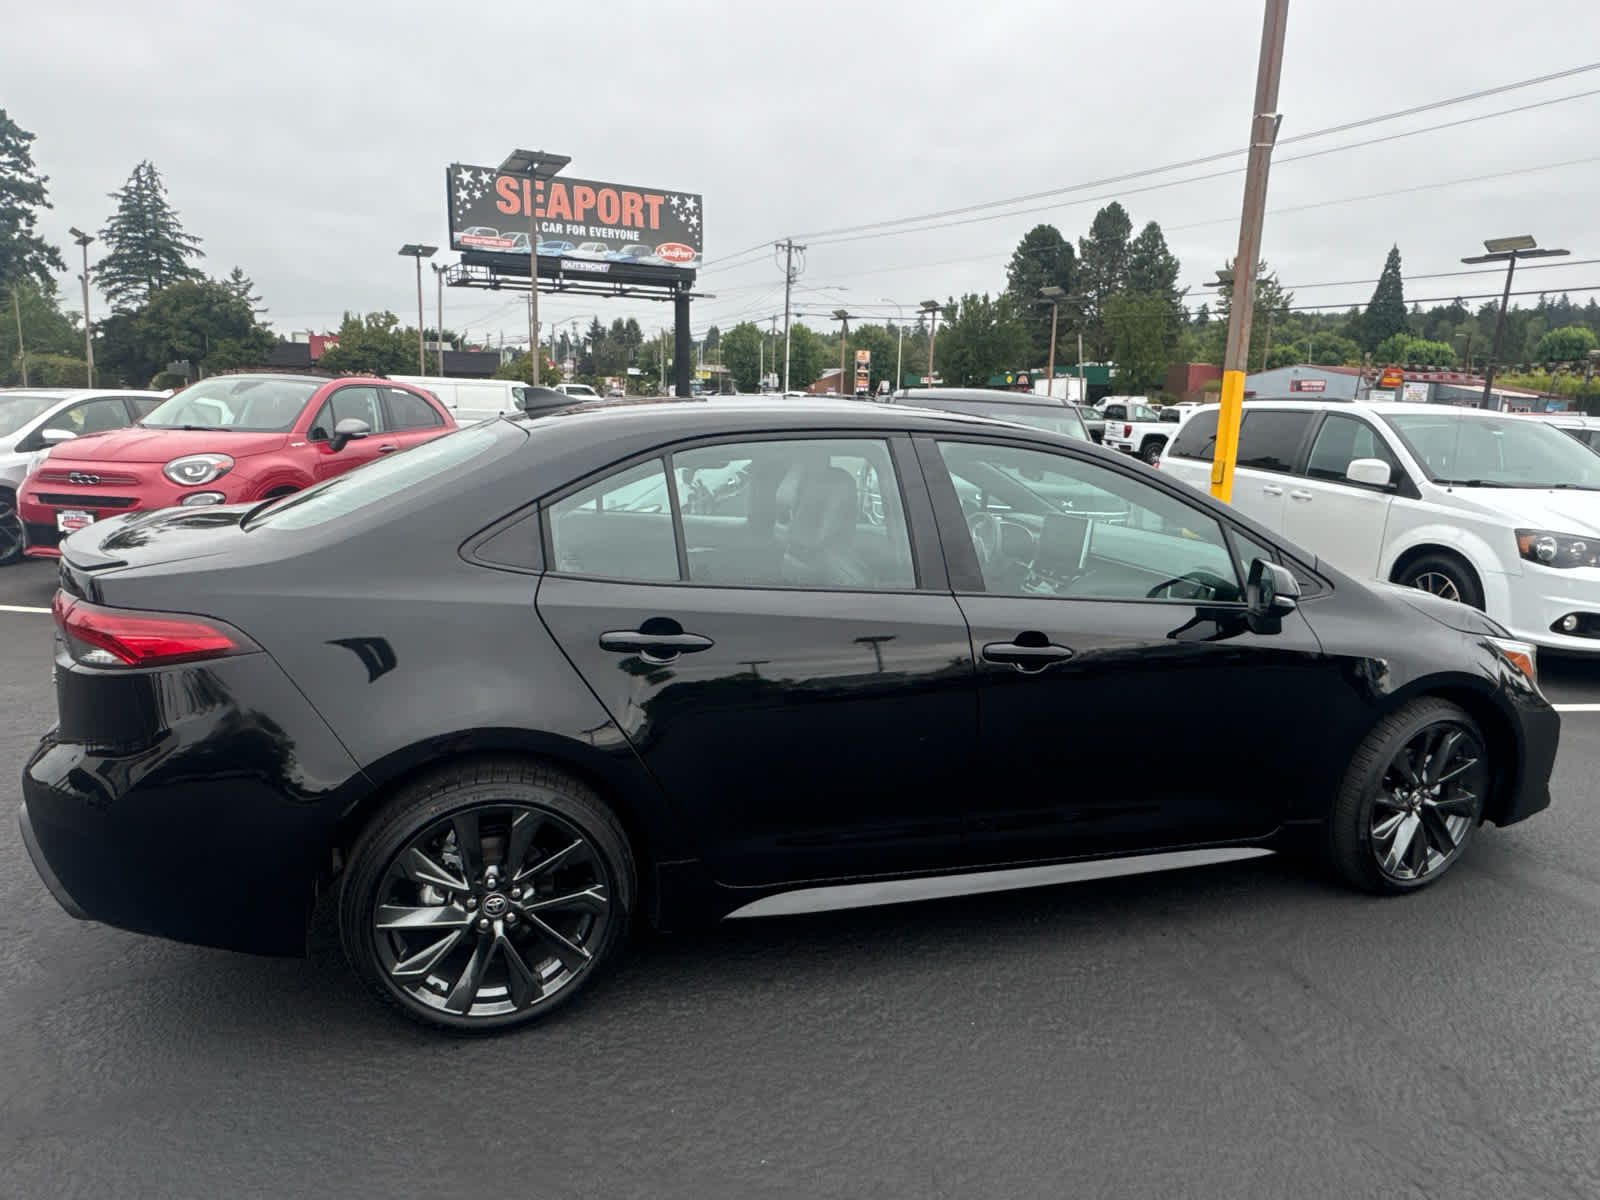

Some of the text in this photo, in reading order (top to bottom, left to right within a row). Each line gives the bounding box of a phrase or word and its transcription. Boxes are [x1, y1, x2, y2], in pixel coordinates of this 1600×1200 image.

[496, 176, 665, 229] SEAPORT
[541, 222, 563, 234] CAR
[566, 224, 586, 237] FOR
[589, 226, 640, 241] EVERYONE
